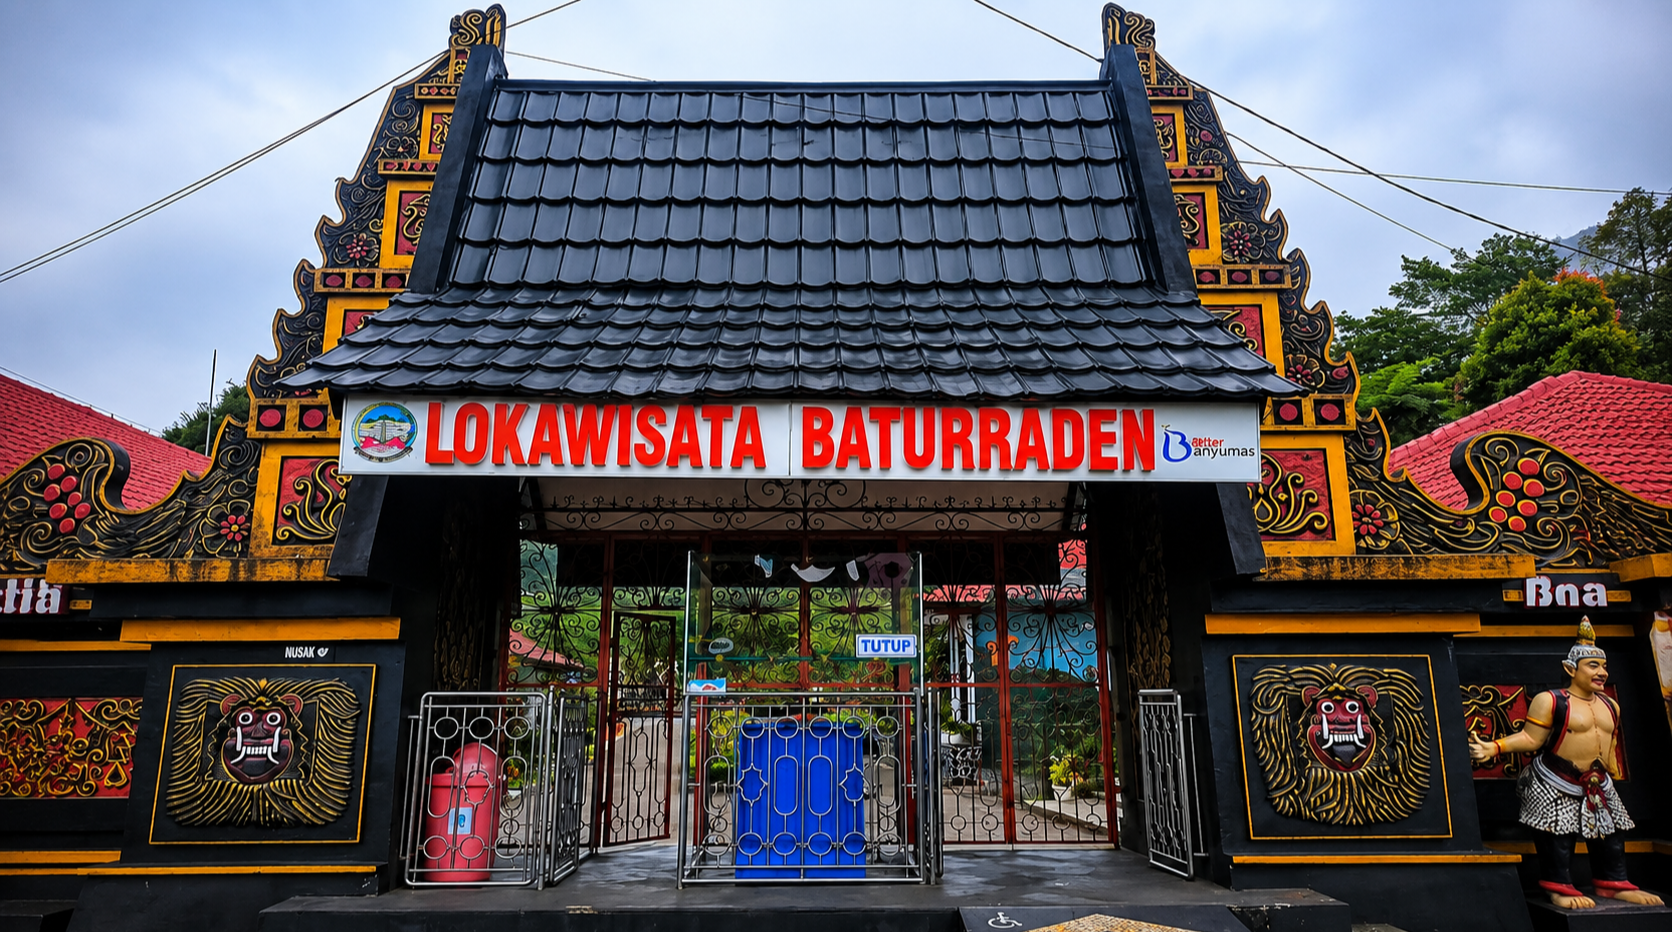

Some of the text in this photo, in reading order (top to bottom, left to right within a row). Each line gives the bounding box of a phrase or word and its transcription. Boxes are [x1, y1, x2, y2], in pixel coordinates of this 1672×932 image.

[425, 402, 1155, 471] LOKAWISATA BATURRADEN
[1525, 575, 1608, 607] Bna
[284, 646, 316, 659] NUSAK
[861, 639, 911, 653] TUTUP
